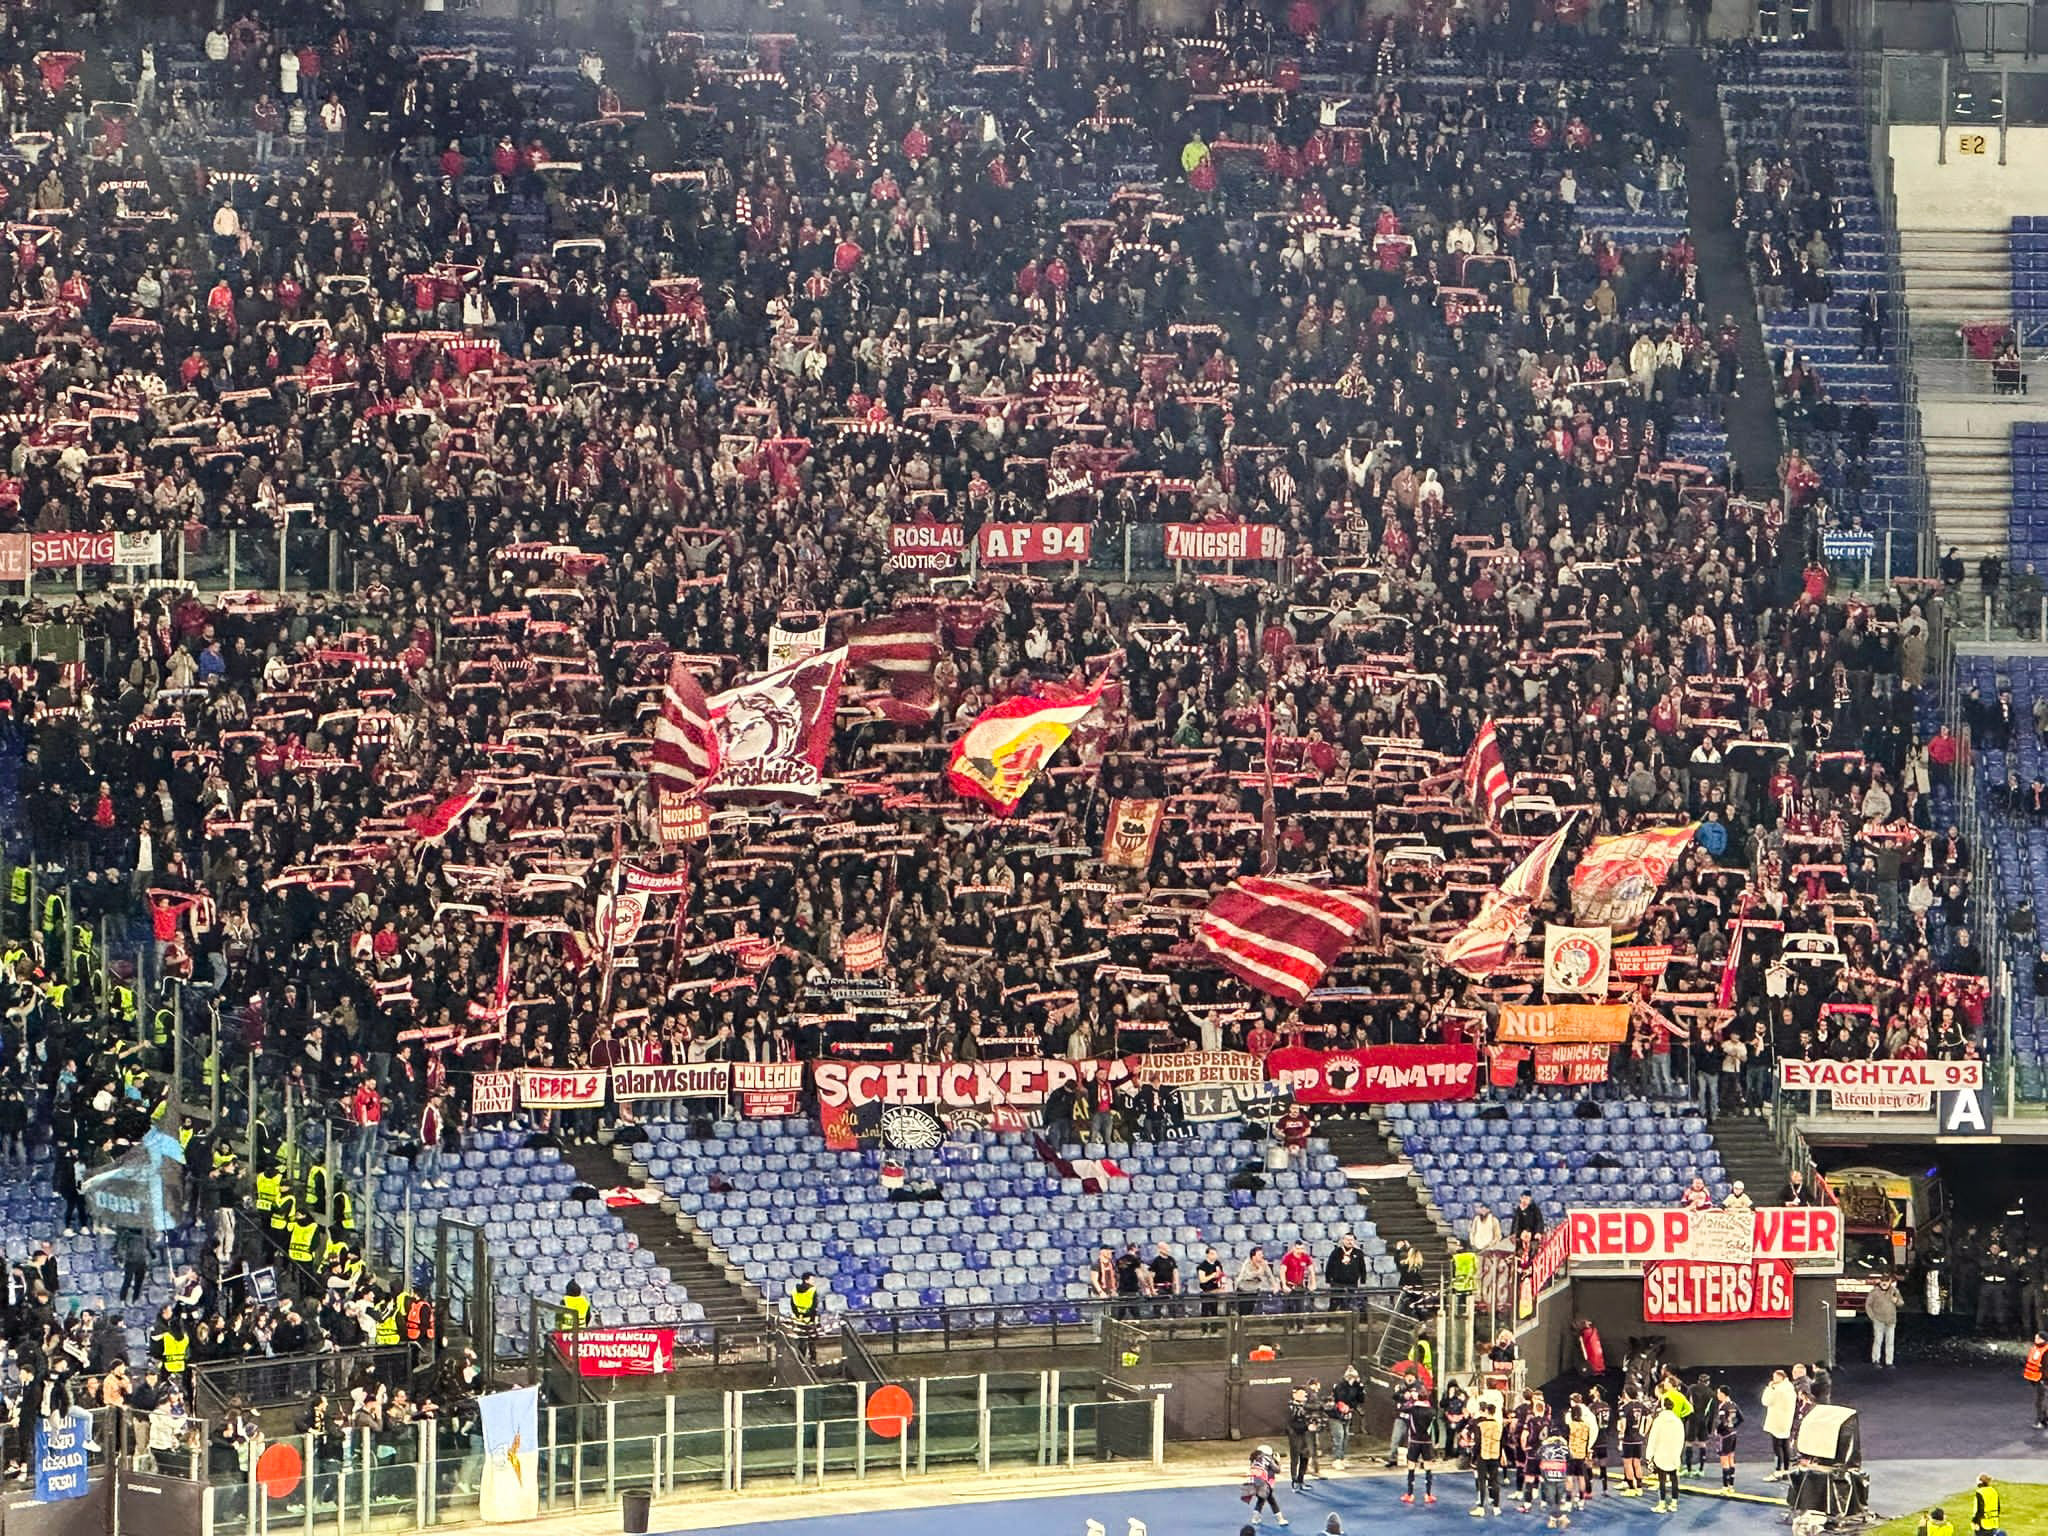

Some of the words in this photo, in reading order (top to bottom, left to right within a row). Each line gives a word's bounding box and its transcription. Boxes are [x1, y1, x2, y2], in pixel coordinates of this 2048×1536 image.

[31, 537, 113, 563] SENZIG
[988, 528, 1030, 557] AF
[1042, 526, 1084, 555] 94
[1167, 525, 1248, 557] Zwiesel
[1504, 1011, 1555, 1036] NO!
[475, 1073, 512, 1087] SEEN
[614, 1068, 728, 1095] alarMstufe
[734, 1065, 802, 1089] COLEGIO
[1199, 1066, 1222, 1083] BEI
[1225, 1066, 1259, 1082] UNS
[1365, 1062, 1476, 1089] FANATIC
[1785, 1064, 1935, 1085] EYACHTAL
[1945, 1065, 1979, 1085] 93
[475, 1086, 511, 1100] LAND
[529, 1076, 598, 1099] REBELS
[474, 1100, 509, 1112] FRONT
[1946, 1088, 1986, 1131] A
[1571, 1212, 1655, 1255] RED
[1664, 1210, 1836, 1254] PWER
[1647, 1263, 1753, 1316] SELTERS
[1758, 1262, 1790, 1312] Ts.
